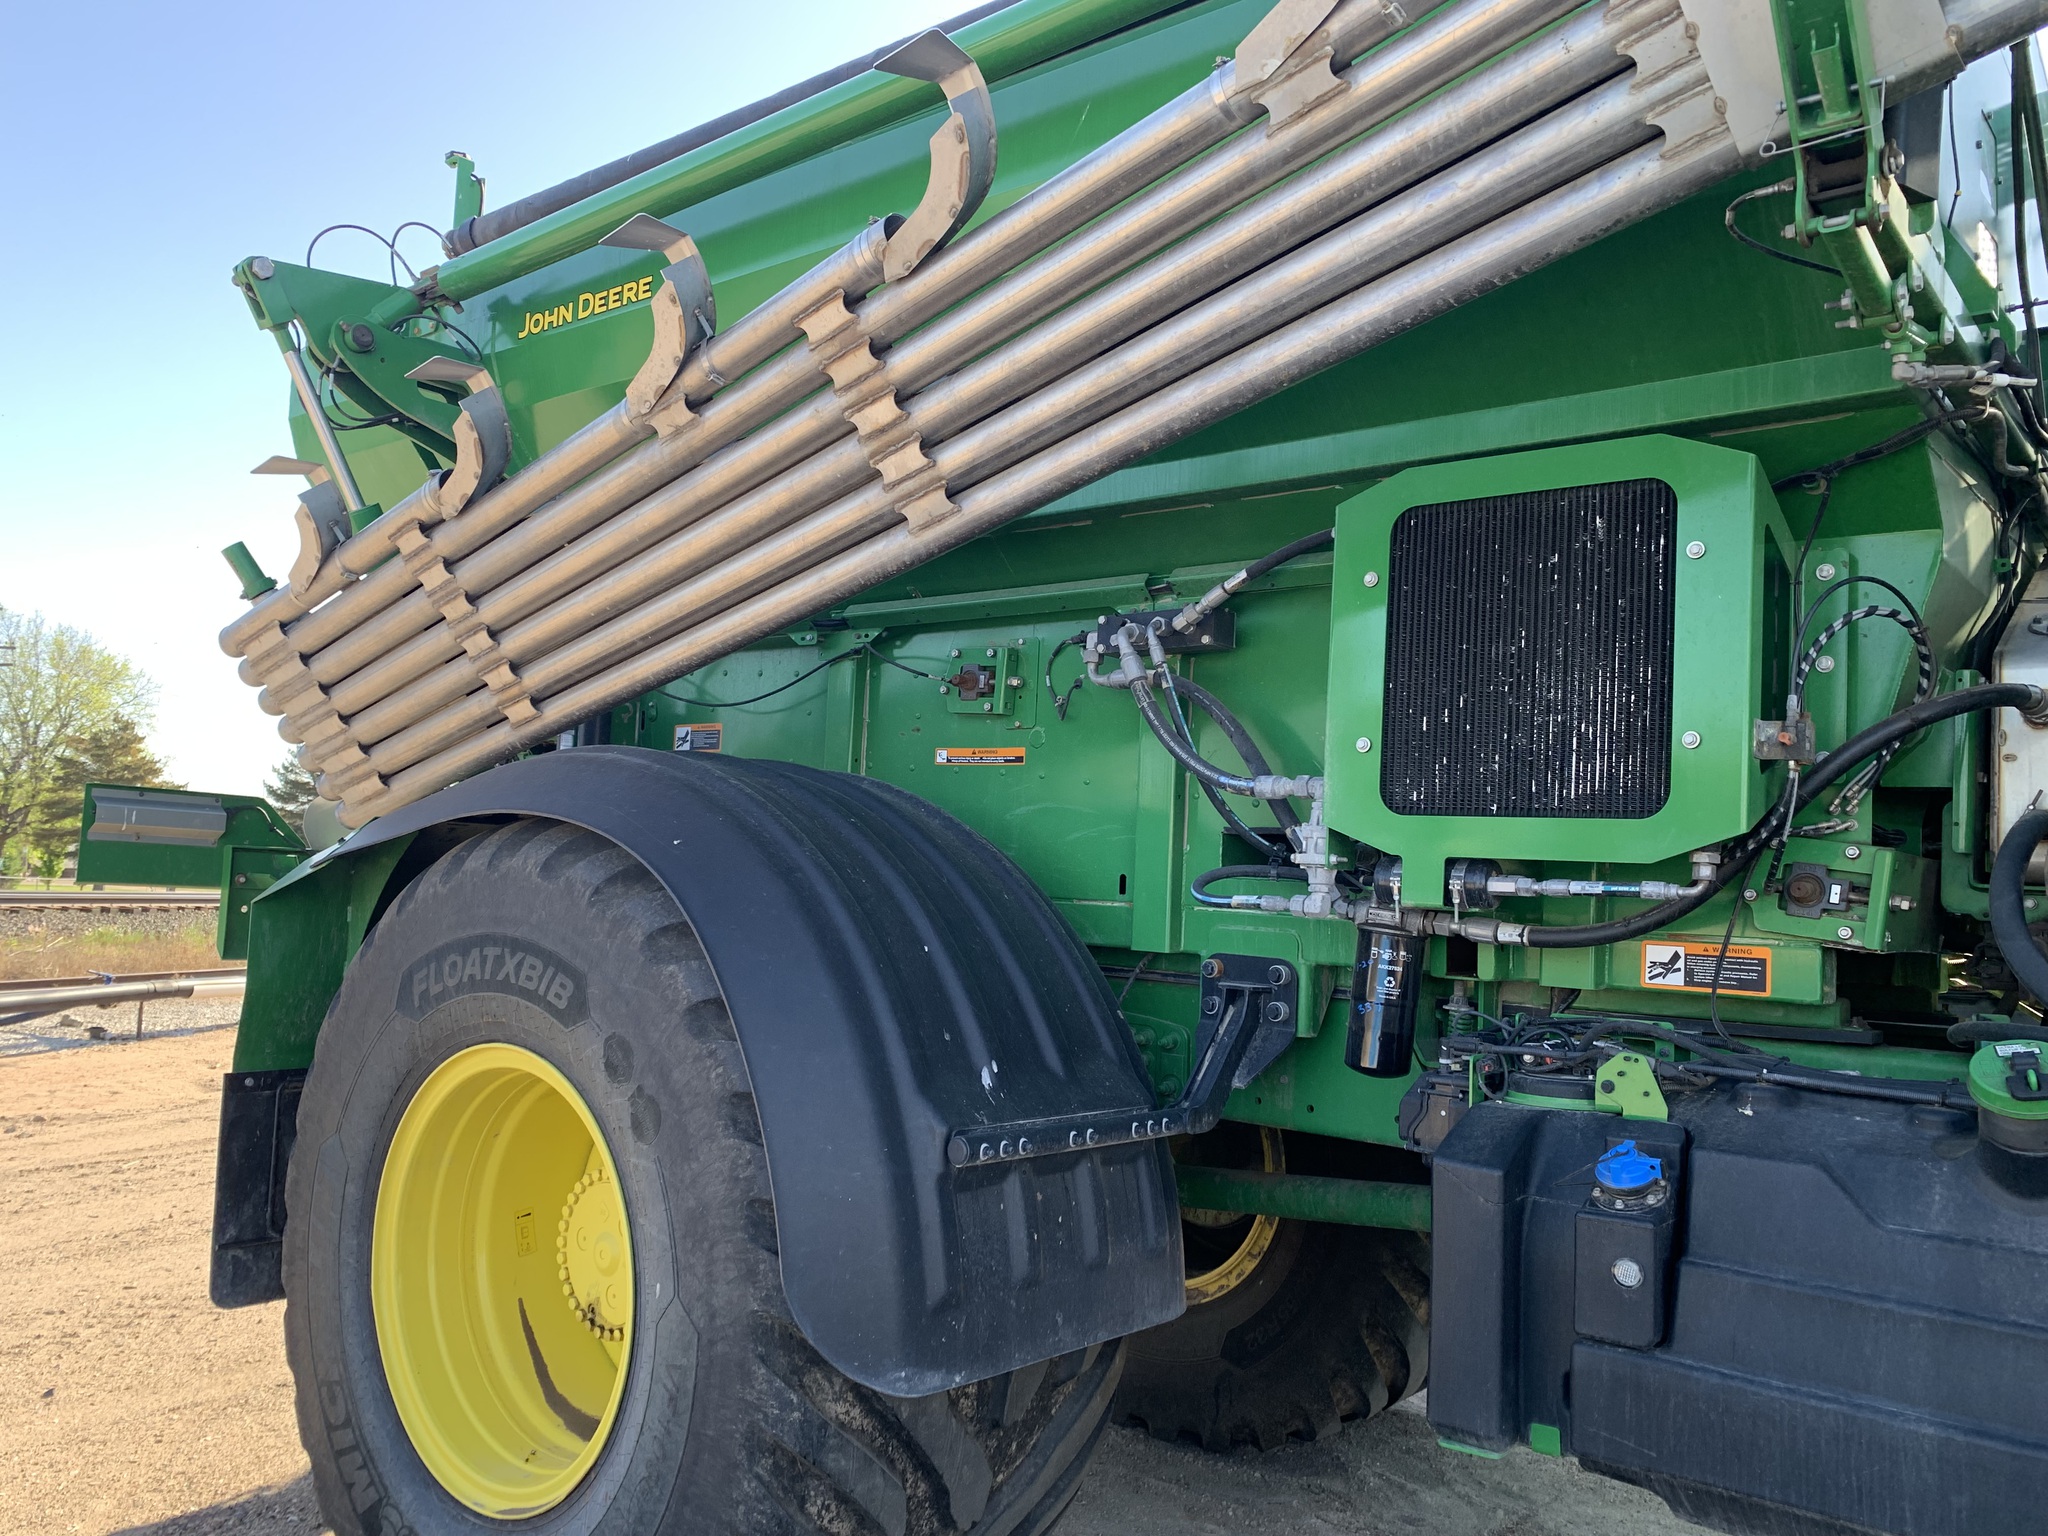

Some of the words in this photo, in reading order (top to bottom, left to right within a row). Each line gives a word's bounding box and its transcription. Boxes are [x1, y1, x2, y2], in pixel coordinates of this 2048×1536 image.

[518, 302, 574, 339] JOHN
[577, 275, 653, 321] DEERE
[412, 946, 575, 1010] FLOATXBIB
[1712, 947, 1753, 955] WRNING
